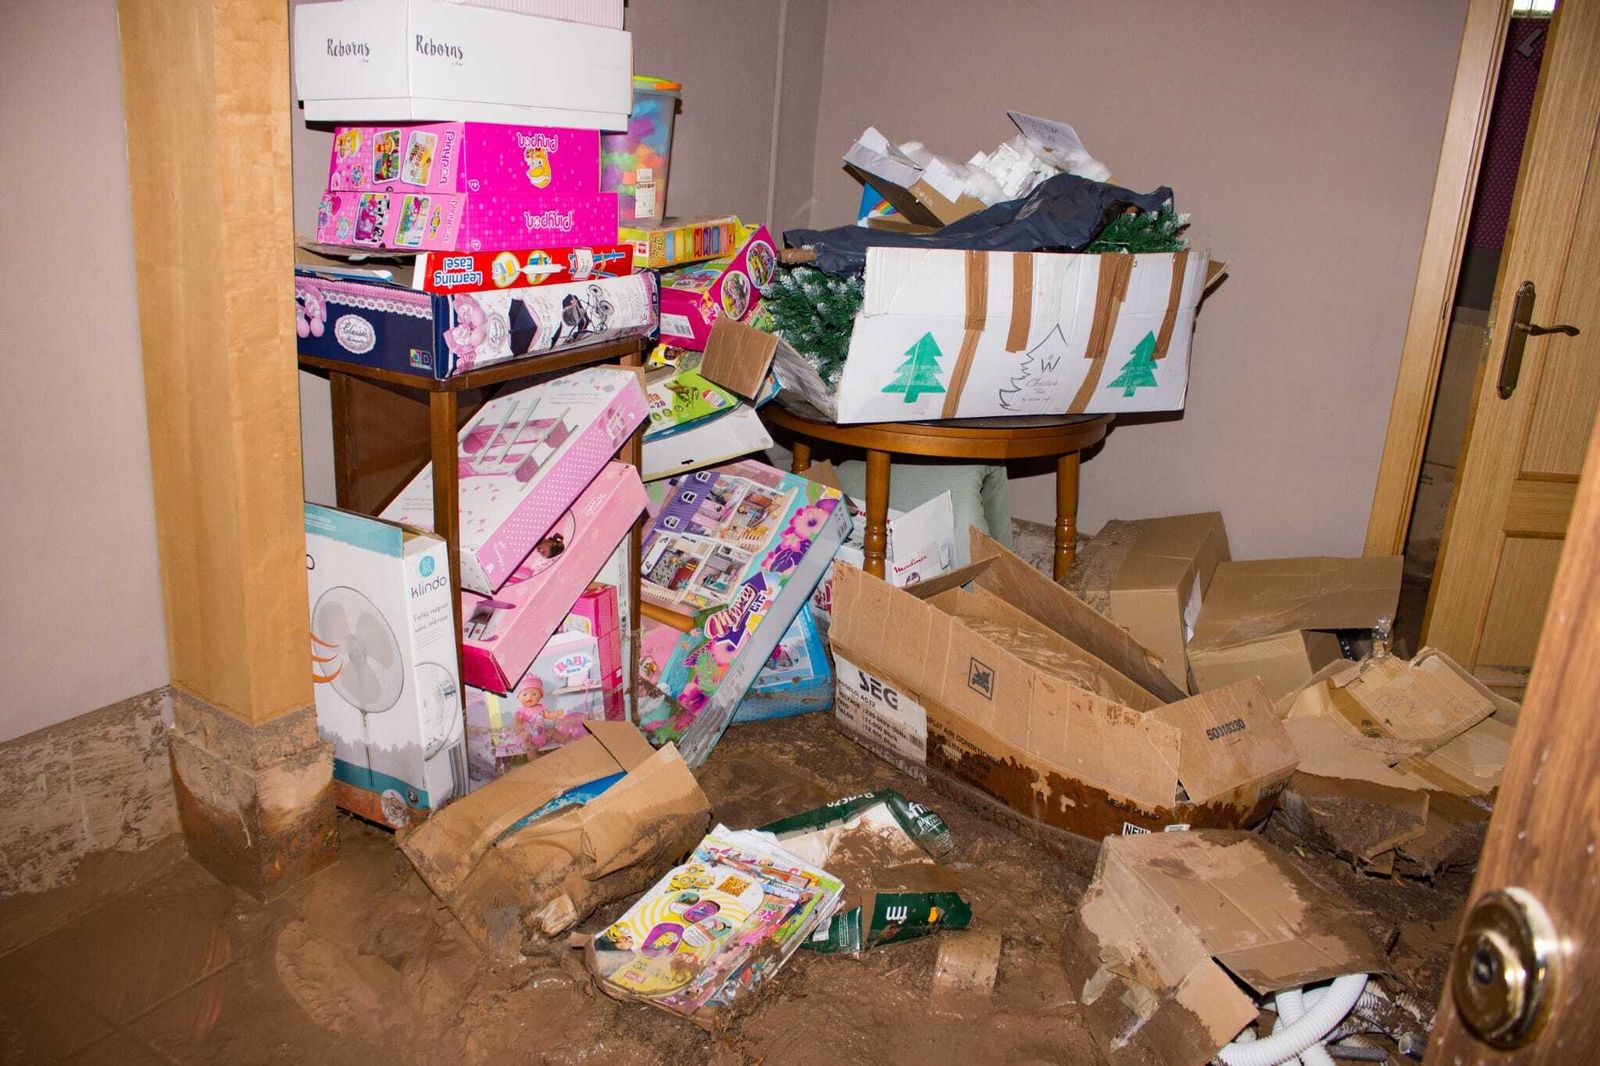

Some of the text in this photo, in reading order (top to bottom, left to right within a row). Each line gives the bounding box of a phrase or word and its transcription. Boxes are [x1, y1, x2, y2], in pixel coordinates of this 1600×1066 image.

[326, 38, 370, 56] Reborns
[415, 33, 463, 60] Reborns
[444, 257, 473, 271] Easel
[434, 271, 482, 287] Learning
[411, 576, 447, 599] klindo
[554, 655, 592, 672] BABY
[858, 670, 899, 711] SEG
